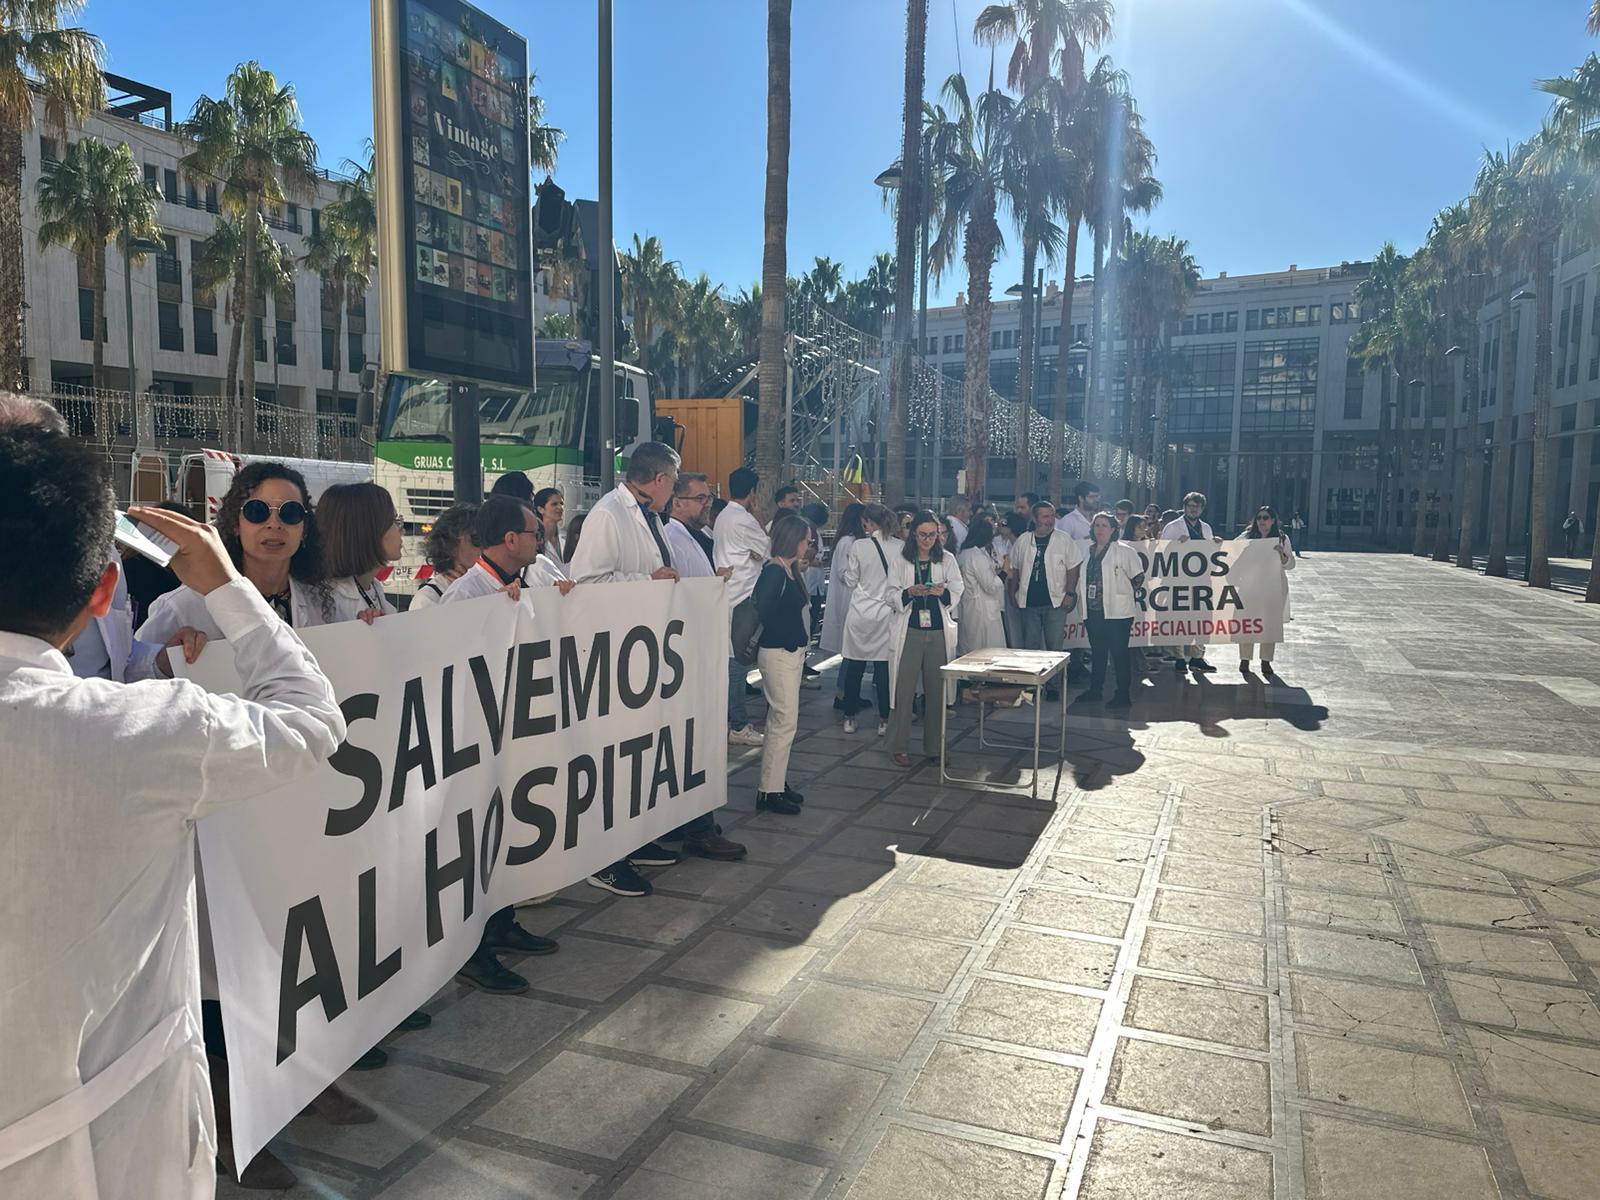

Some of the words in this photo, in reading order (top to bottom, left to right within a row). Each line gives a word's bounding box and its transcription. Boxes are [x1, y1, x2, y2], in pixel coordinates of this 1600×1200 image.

[433, 111, 499, 161] Vintage
[413, 455, 443, 469] GRUAS
[324, 619, 685, 837] SALVEMOS
[275, 866, 402, 1067] AL
[424, 717, 706, 948] HOSPITAL
